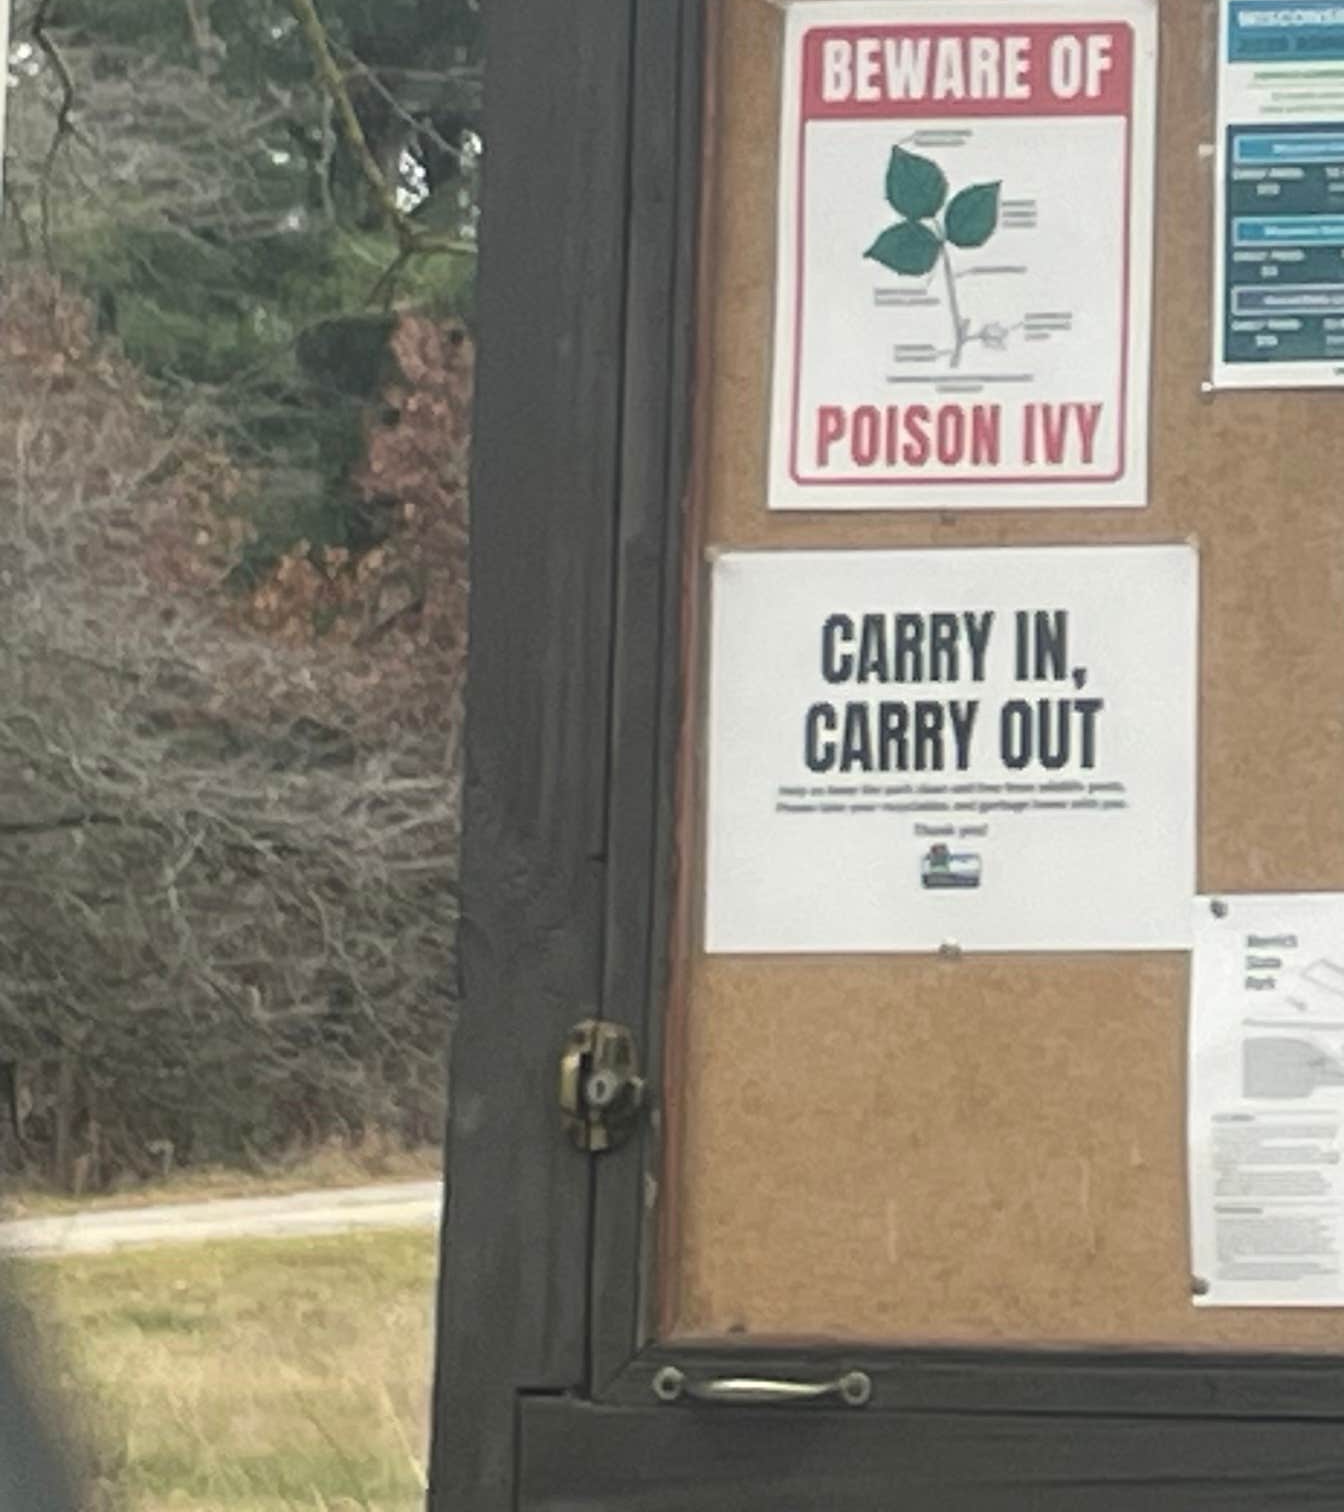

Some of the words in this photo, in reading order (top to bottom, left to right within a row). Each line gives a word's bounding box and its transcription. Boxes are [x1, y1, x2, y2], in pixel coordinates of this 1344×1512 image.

[822, 36, 1032, 103] BEWARE
[1050, 33, 1114, 100] OF
[816, 404, 999, 468] POISON
[1021, 402, 1104, 466] IVY
[820, 610, 995, 685] CARRY
[1014, 608, 1087, 690] IN,
[804, 699, 980, 774] CARRY
[998, 697, 1104, 770] OUT
